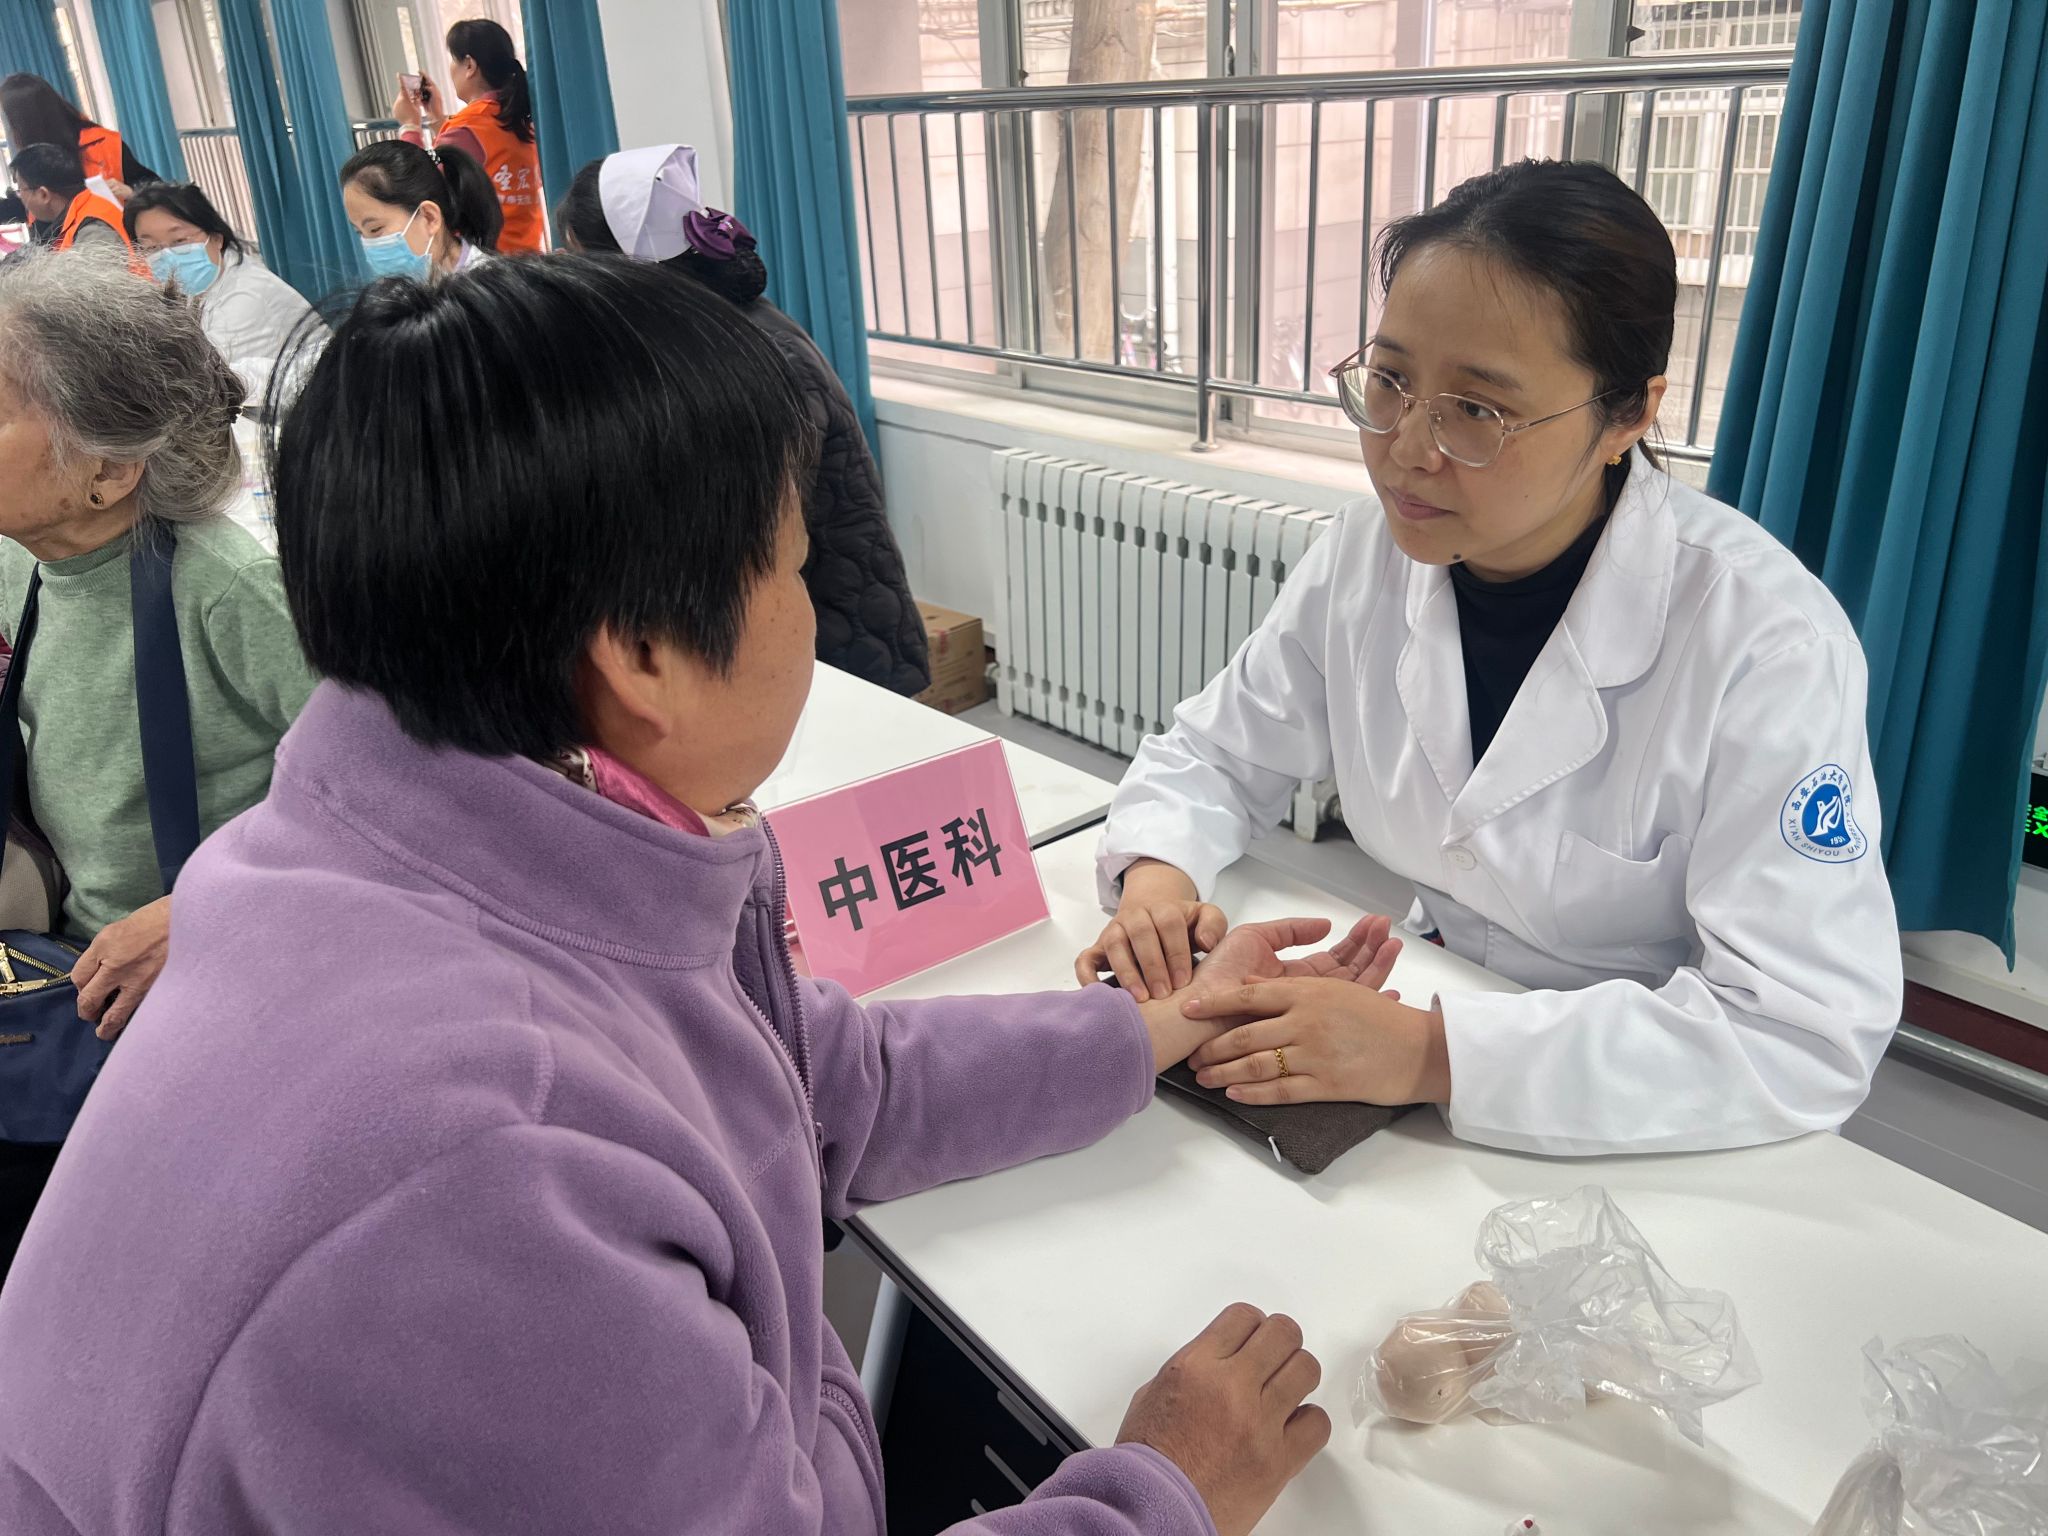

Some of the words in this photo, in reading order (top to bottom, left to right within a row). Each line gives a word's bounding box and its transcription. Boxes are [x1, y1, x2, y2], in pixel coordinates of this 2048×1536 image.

[818, 808, 1002, 931] 中医科
[1801, 842, 1840, 857] SHIYOU
